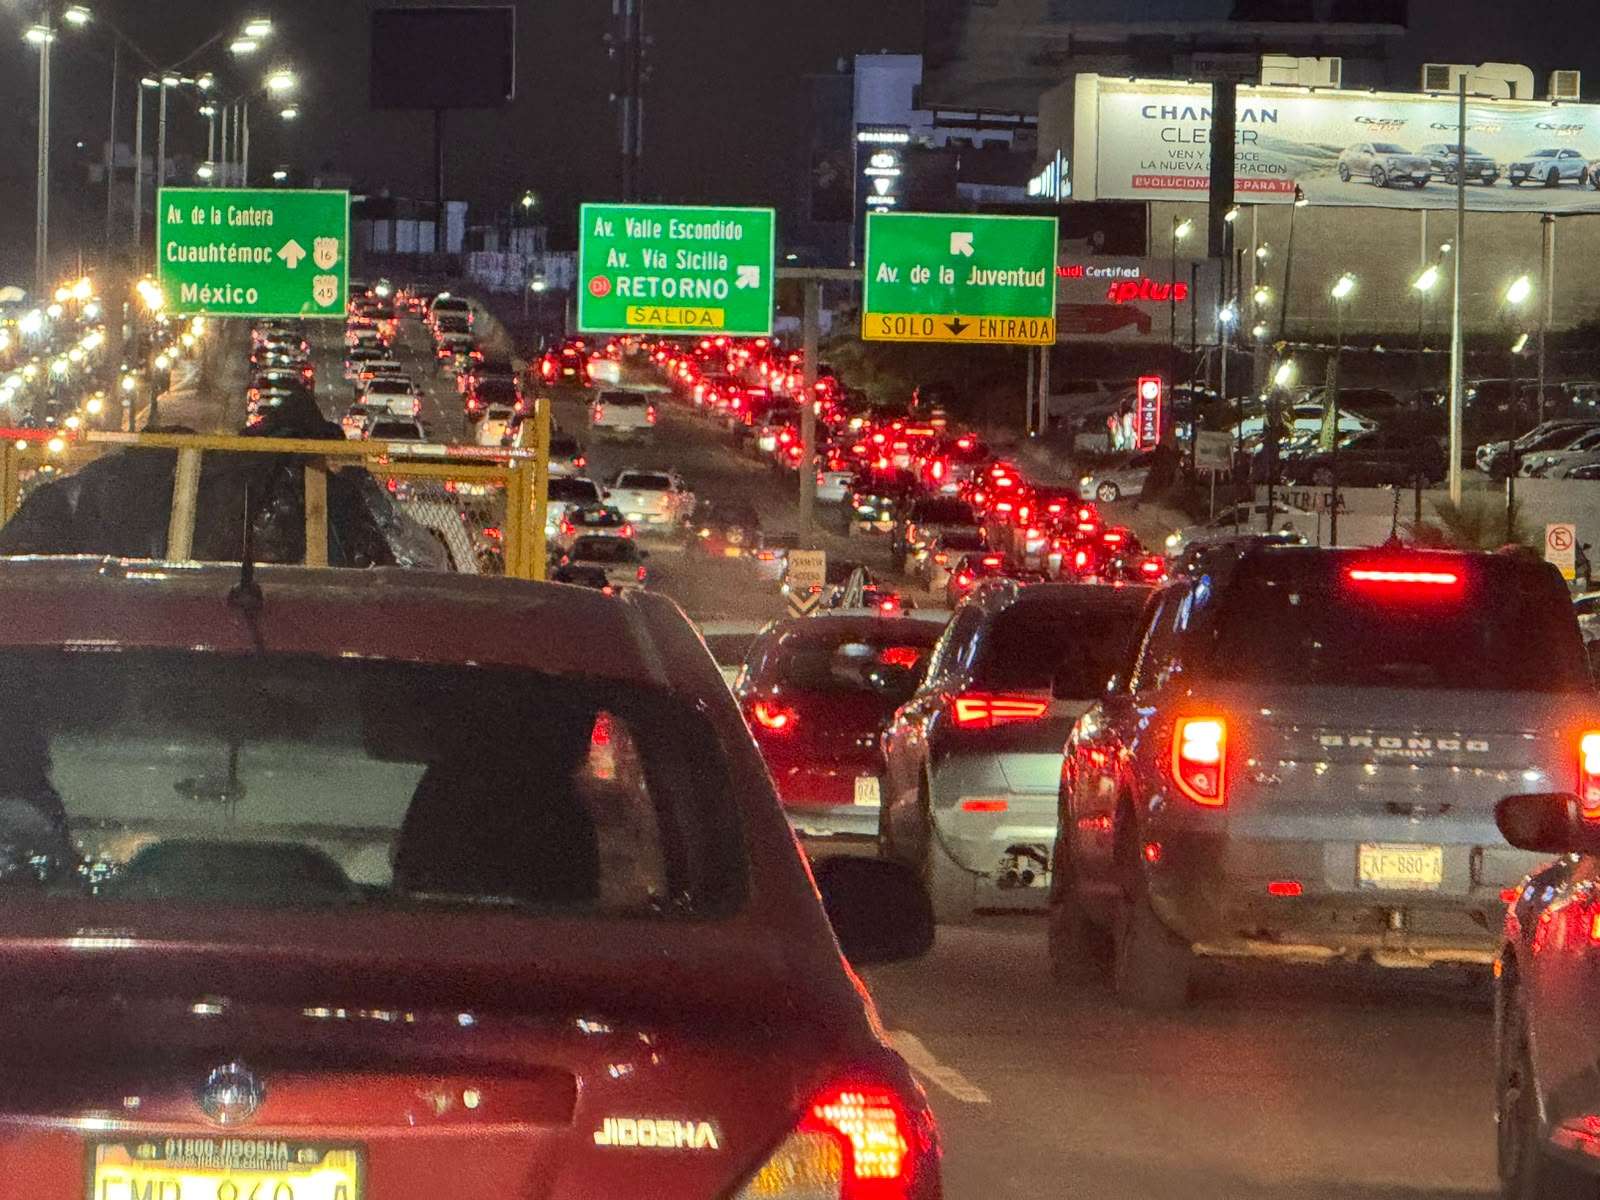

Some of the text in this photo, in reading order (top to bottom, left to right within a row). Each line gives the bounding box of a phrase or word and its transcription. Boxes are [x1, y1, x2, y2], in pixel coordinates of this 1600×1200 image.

[1142, 105, 1278, 123] CHANAN
[1161, 127, 1258, 145] CLEER
[1168, 149, 1194, 159] VEN
[1197, 151, 1206, 159] Y
[1141, 161, 1157, 170] LA
[1160, 161, 1202, 171] NUEVA
[1244, 180, 1276, 191] PARA
[167, 204, 273, 226] Av. de la Cantera
[594, 216, 743, 240] Av. Valle Escondido
[167, 241, 272, 263] Cuauhtémoc
[320, 249, 332, 261] 16
[607, 248, 727, 271] Av. Vía Sicilia
[876, 262, 1046, 288] Av. de la Juventud
[1056, 265, 1140, 278] Audi Certified
[181, 283, 258, 304] México
[318, 287, 333, 299] 45
[616, 276, 728, 300] RETORNO
[633, 307, 714, 325] SALIDA
[882, 317, 1050, 339] SOLO ENTRADA
[1319, 735, 1489, 752] BRONCO
[594, 1118, 719, 1149] JIDOSHA
